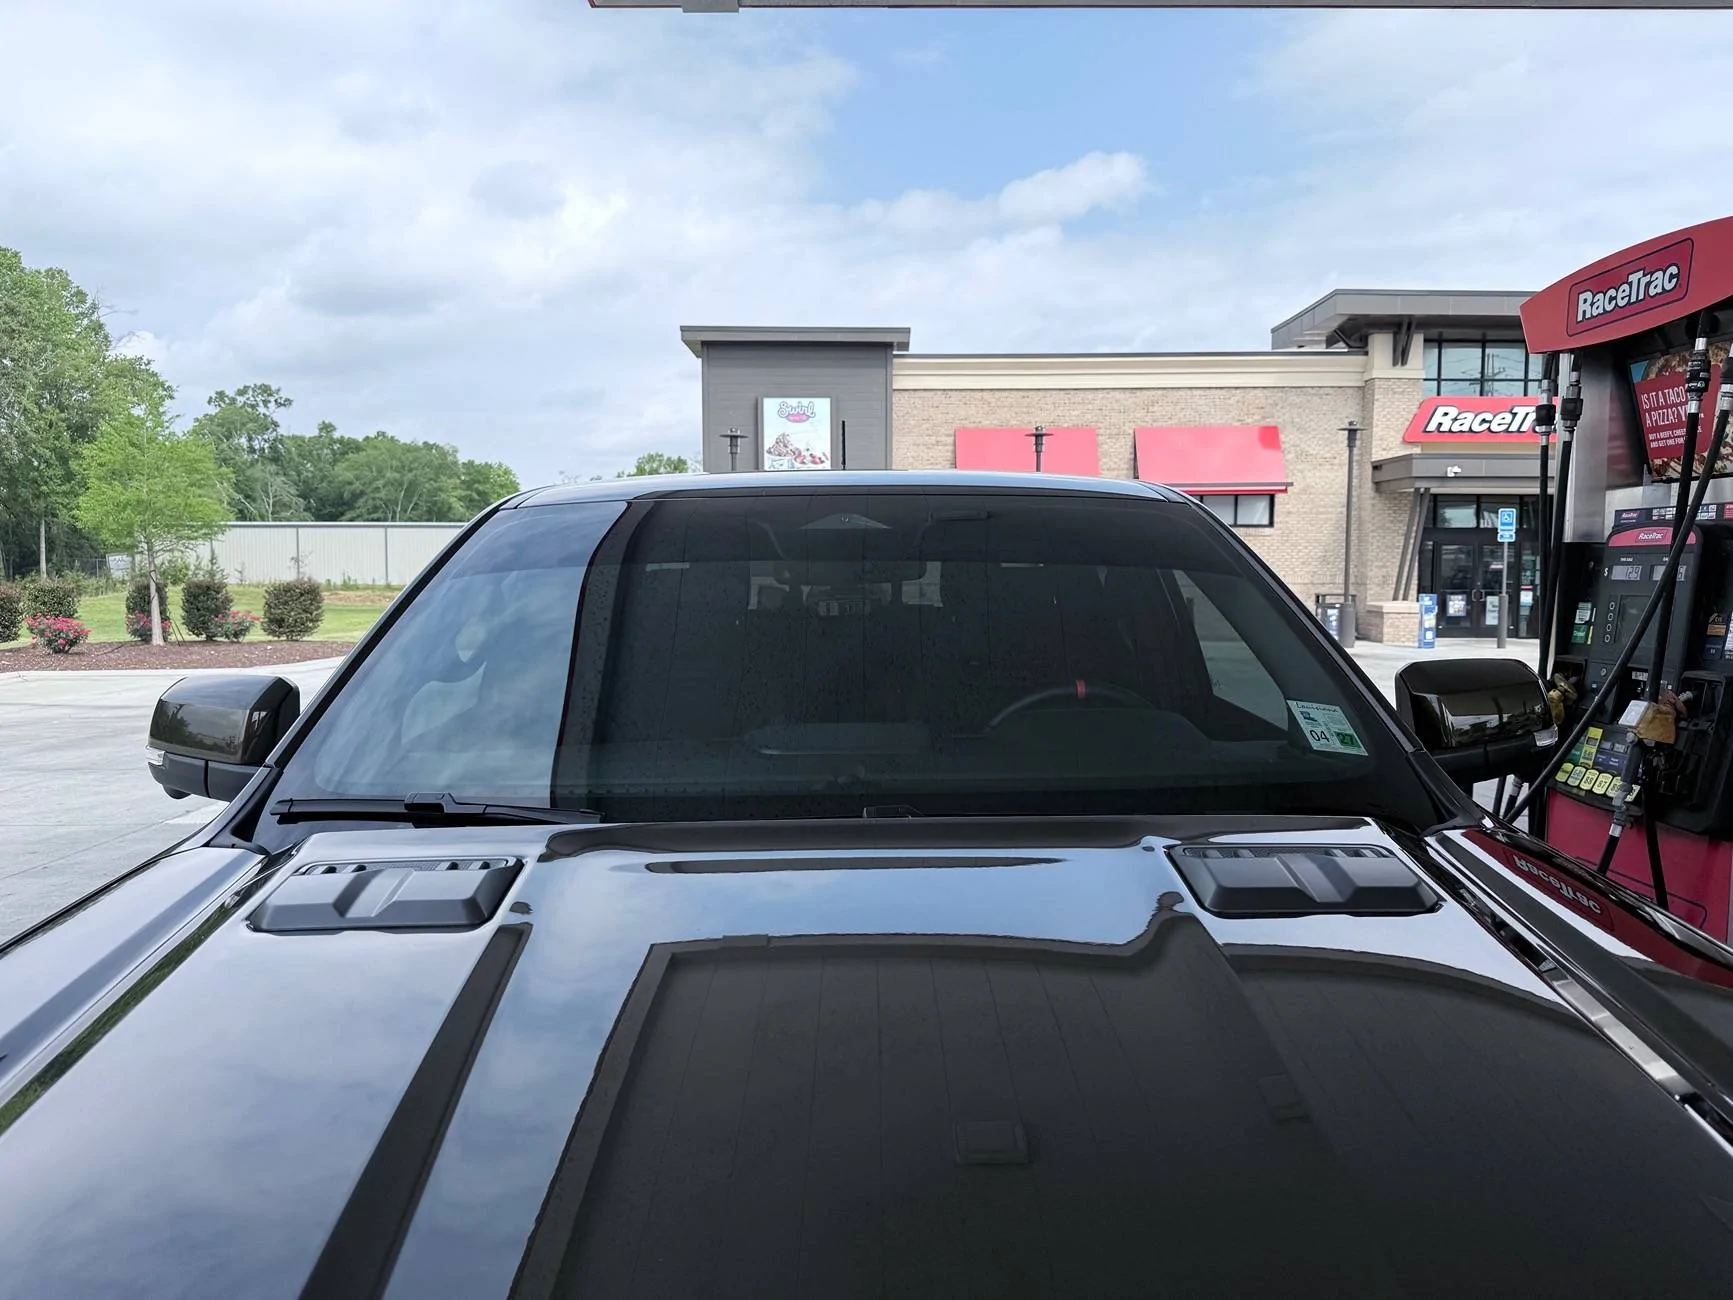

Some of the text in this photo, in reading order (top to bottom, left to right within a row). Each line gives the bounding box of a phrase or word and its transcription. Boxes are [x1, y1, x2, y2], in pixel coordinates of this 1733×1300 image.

[1576, 264, 1680, 323] RaceTrac
[1641, 386, 1686, 409] IS IT A TACO
[778, 401, 816, 419] Swirl
[1423, 404, 1559, 434] RaceTr
[1645, 412, 1652, 428] A
[1651, 407, 1678, 427] PIZZA?
[1638, 532, 1664, 541] RaceTrac
[1309, 730, 1330, 743] 04
